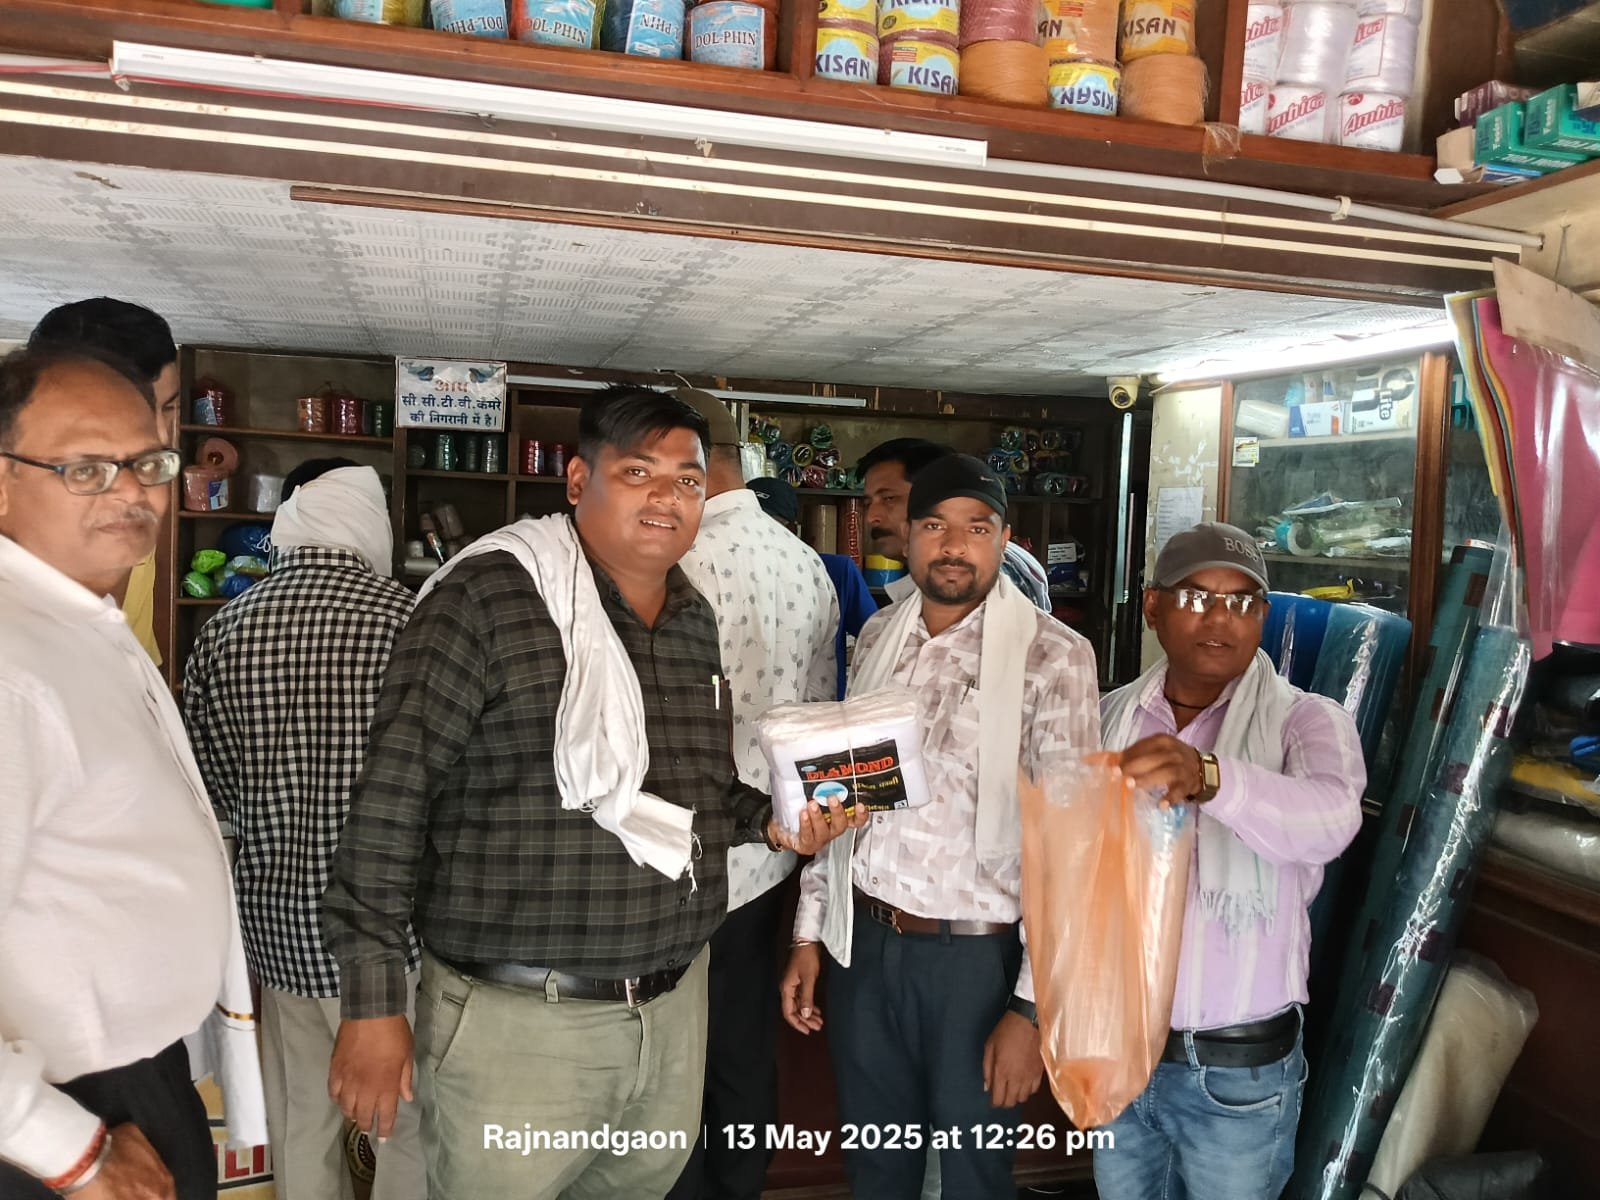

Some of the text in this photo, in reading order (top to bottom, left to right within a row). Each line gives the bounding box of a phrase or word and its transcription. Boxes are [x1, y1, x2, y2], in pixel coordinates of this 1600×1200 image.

[695, 29, 758, 48] DOL-PHIN
[816, 54, 870, 80] KISAN
[1060, 87, 1115, 111] KISAN
[429, 410, 468, 425] निगरानी
